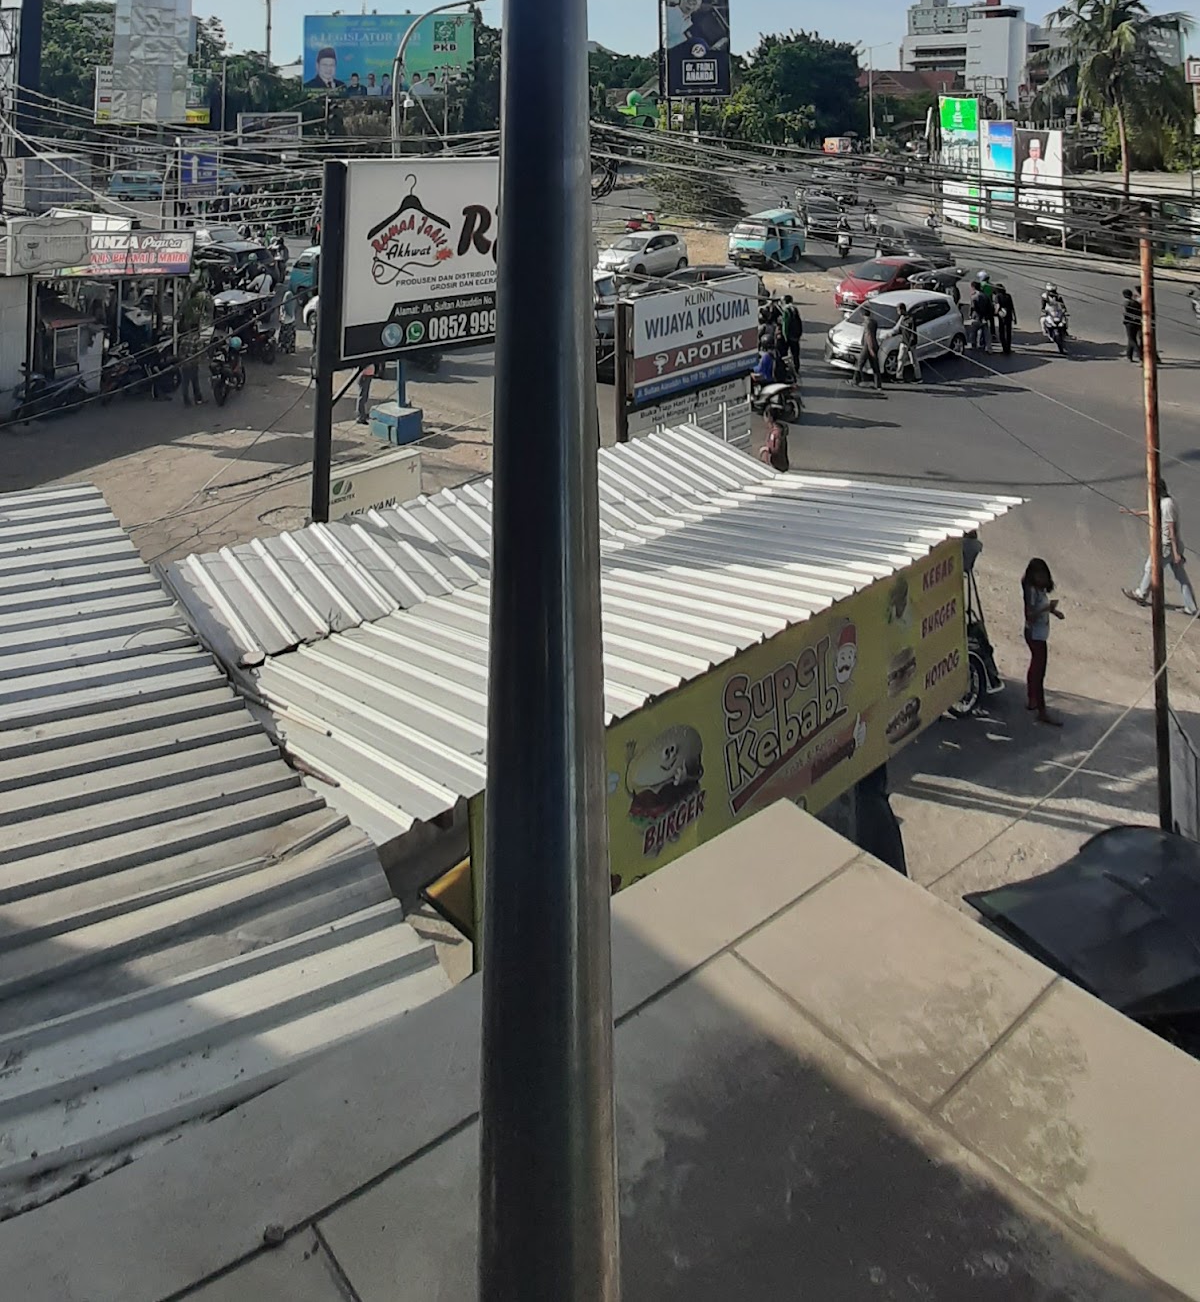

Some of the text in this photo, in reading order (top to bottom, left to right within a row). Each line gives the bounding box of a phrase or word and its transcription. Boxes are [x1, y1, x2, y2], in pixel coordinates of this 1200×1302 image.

[320, 32, 393, 42] LEGISLATOR
[433, 44, 457, 52] PKB
[457, 204, 498, 264] R
[385, 243, 432, 260] Akhwat
[395, 276, 437, 287] PRODUSEN
[438, 274, 453, 282] DAN
[430, 282, 458, 291] GROSIR
[459, 279, 474, 288] DAN
[434, 301, 455, 311] Sultan
[684, 290, 715, 306] KLINIK
[428, 314, 467, 341] 0852
[645, 298, 750, 340] WIJAYA KUSUMA
[696, 330, 704, 339] &
[675, 335, 743, 367] APOTEK
[923, 555, 955, 591] KEBAB
[921, 598, 957, 639] BURGER
[924, 649, 960, 690] HOTDOG
[722, 634, 831, 736] Super
[723, 678, 840, 796] Kebab
[643, 790, 706, 855] BURGER
